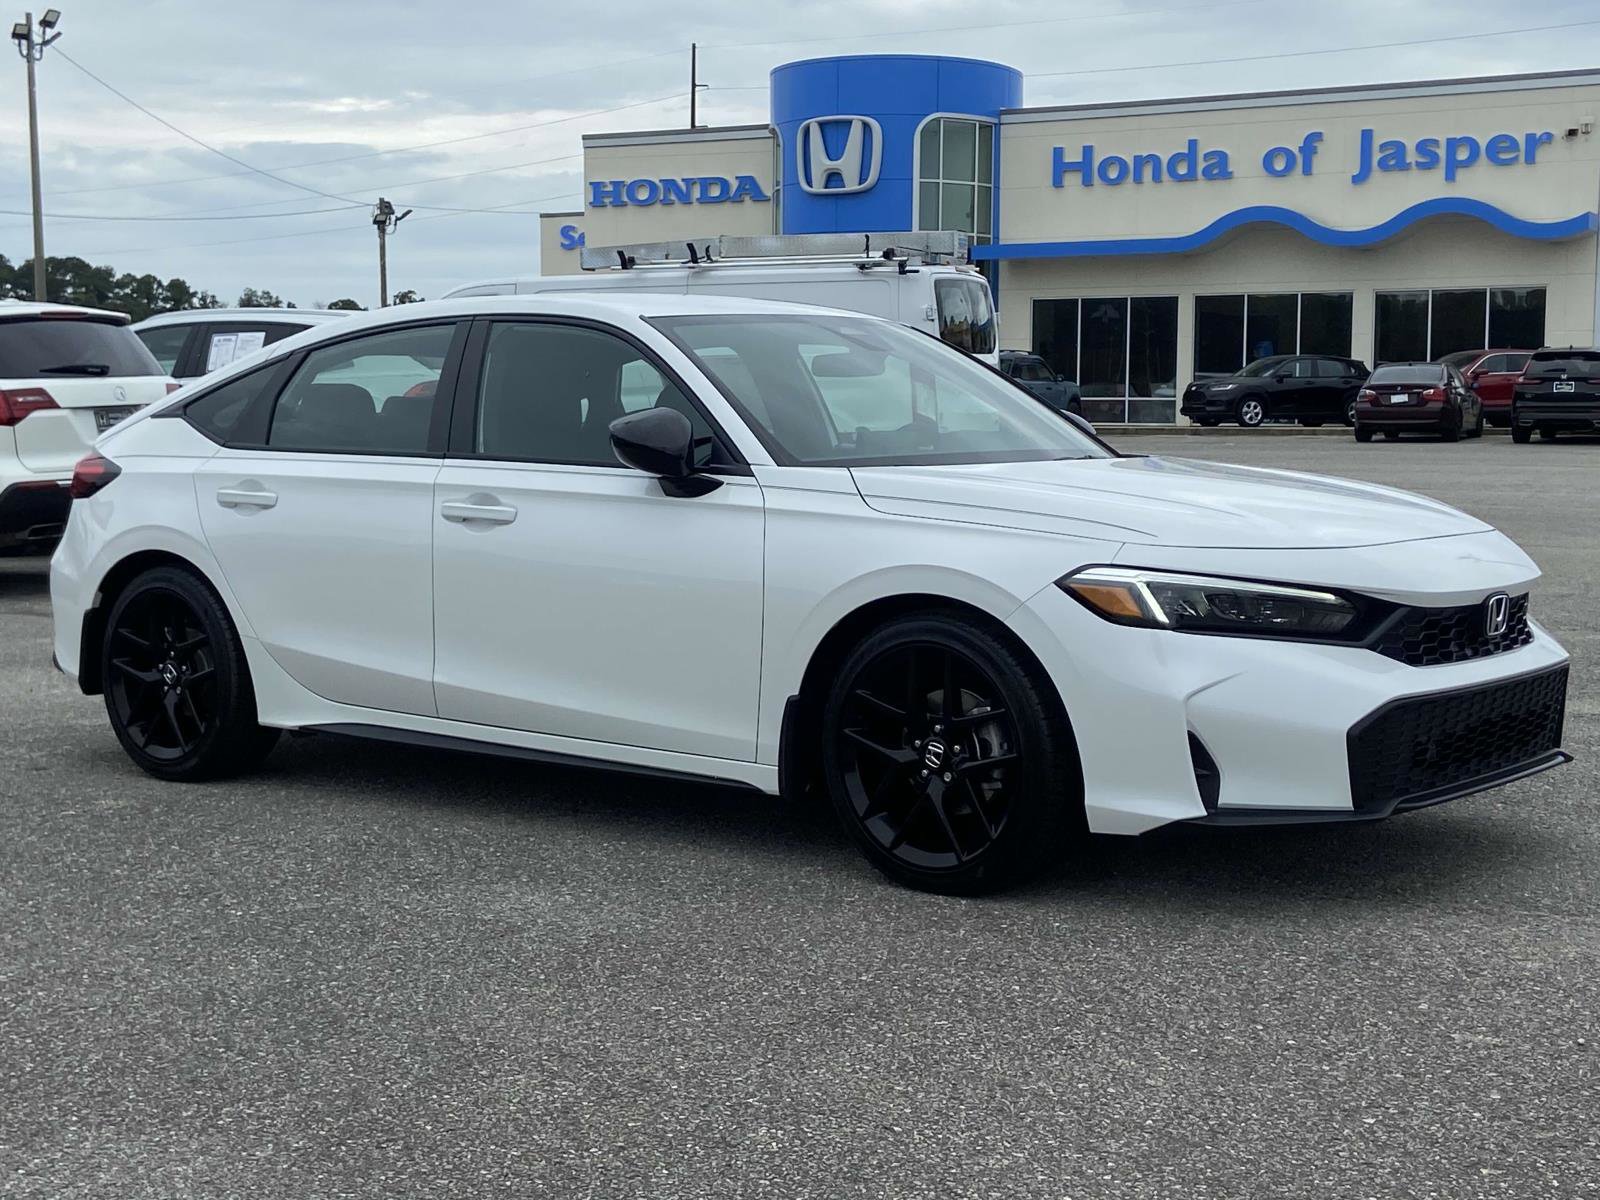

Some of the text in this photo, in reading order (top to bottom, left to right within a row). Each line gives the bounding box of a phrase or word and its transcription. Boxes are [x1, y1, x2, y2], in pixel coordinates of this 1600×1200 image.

[1051, 128, 1554, 188] Honda of Jasper
[588, 175, 771, 208] HONDA
